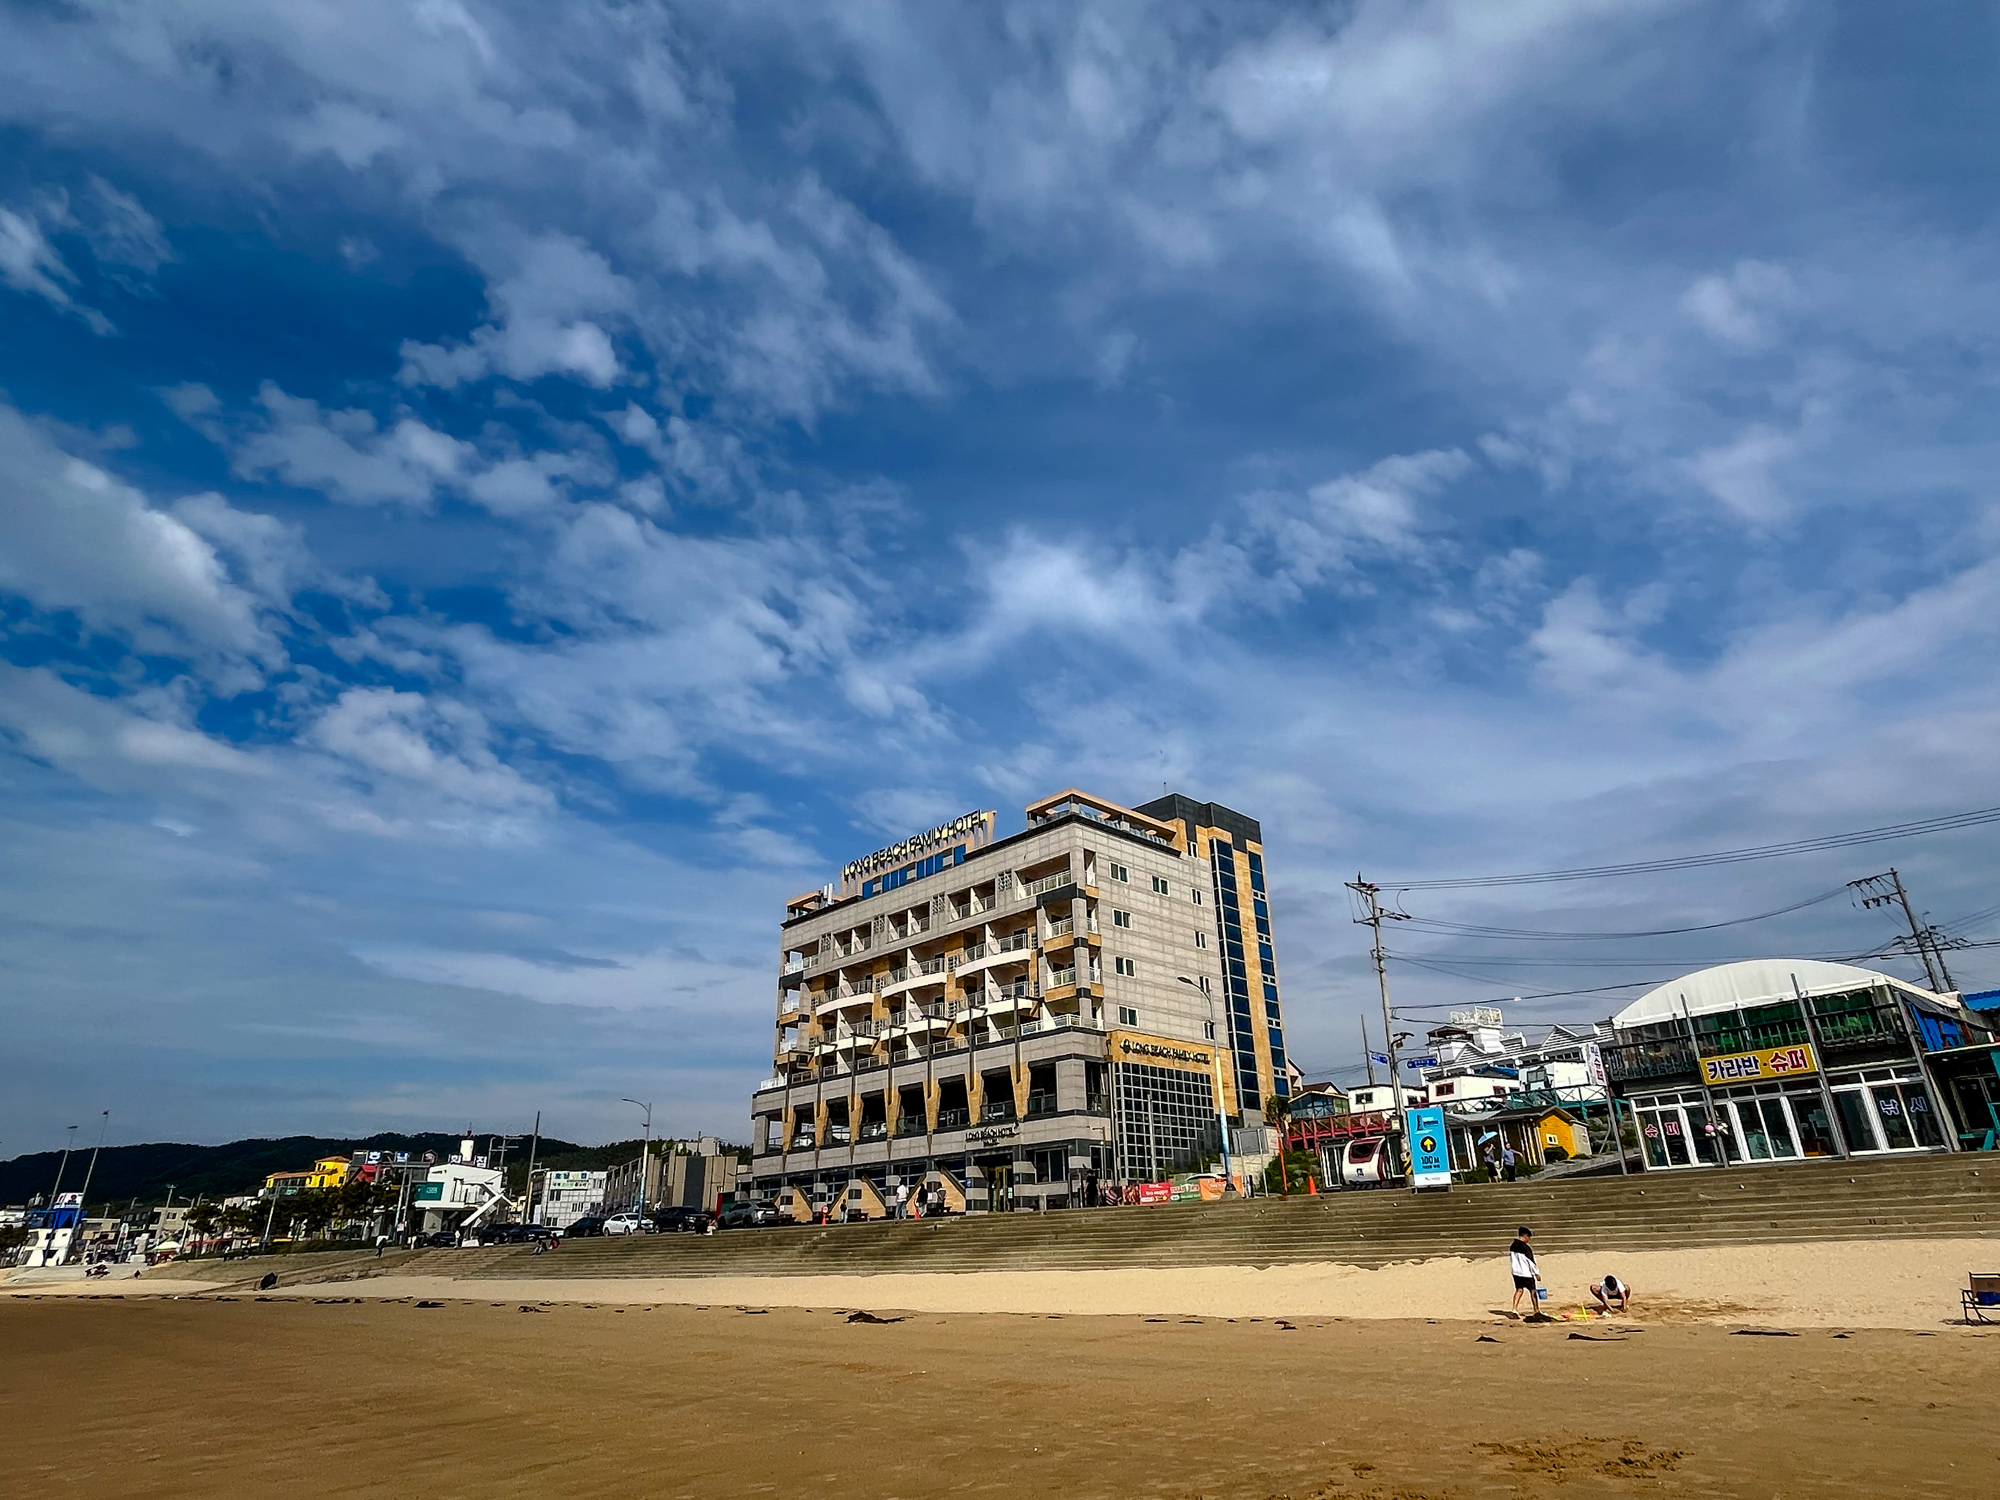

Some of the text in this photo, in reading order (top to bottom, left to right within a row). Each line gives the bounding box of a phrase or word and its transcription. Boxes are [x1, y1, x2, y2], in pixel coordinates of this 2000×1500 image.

[843, 809, 988, 876] LONG BEACH FAMILY HOTEL
[1132, 1041, 1150, 1055] LONG
